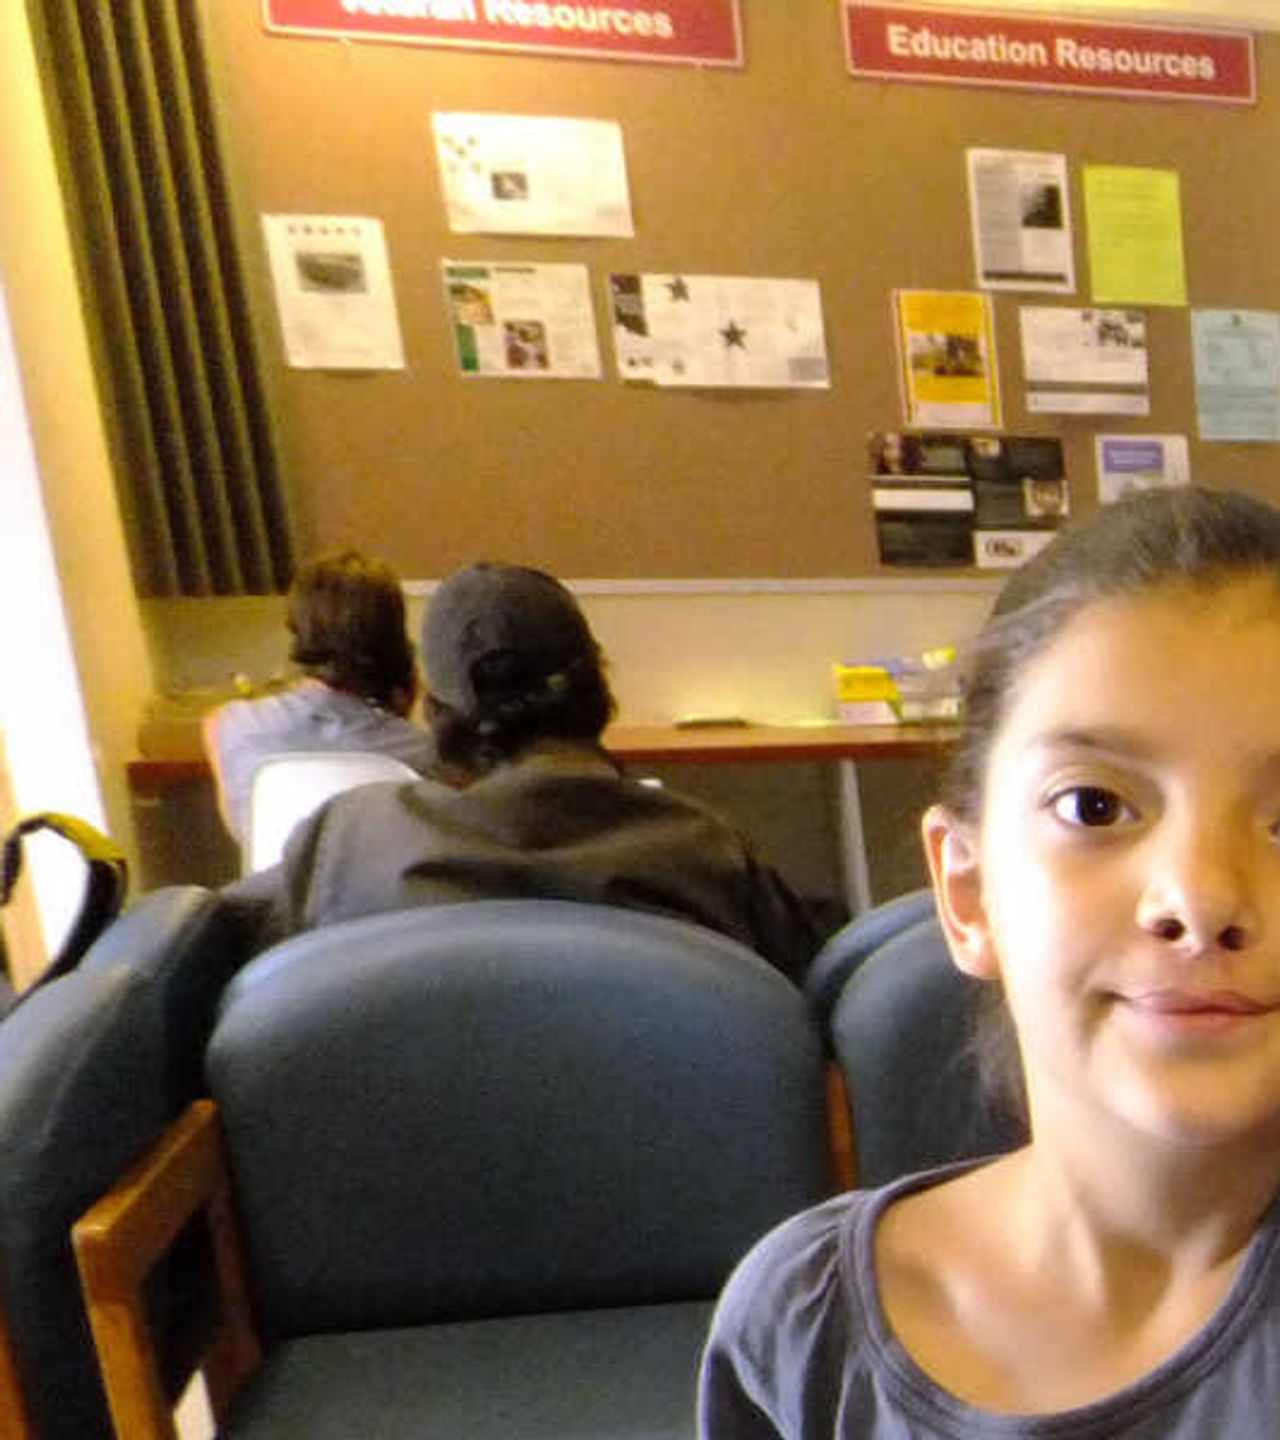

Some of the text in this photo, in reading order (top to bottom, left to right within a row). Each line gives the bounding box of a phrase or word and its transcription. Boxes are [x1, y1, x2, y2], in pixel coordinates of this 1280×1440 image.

[484, 0, 675, 39] Resources
[887, 24, 1216, 79] Education Resources
